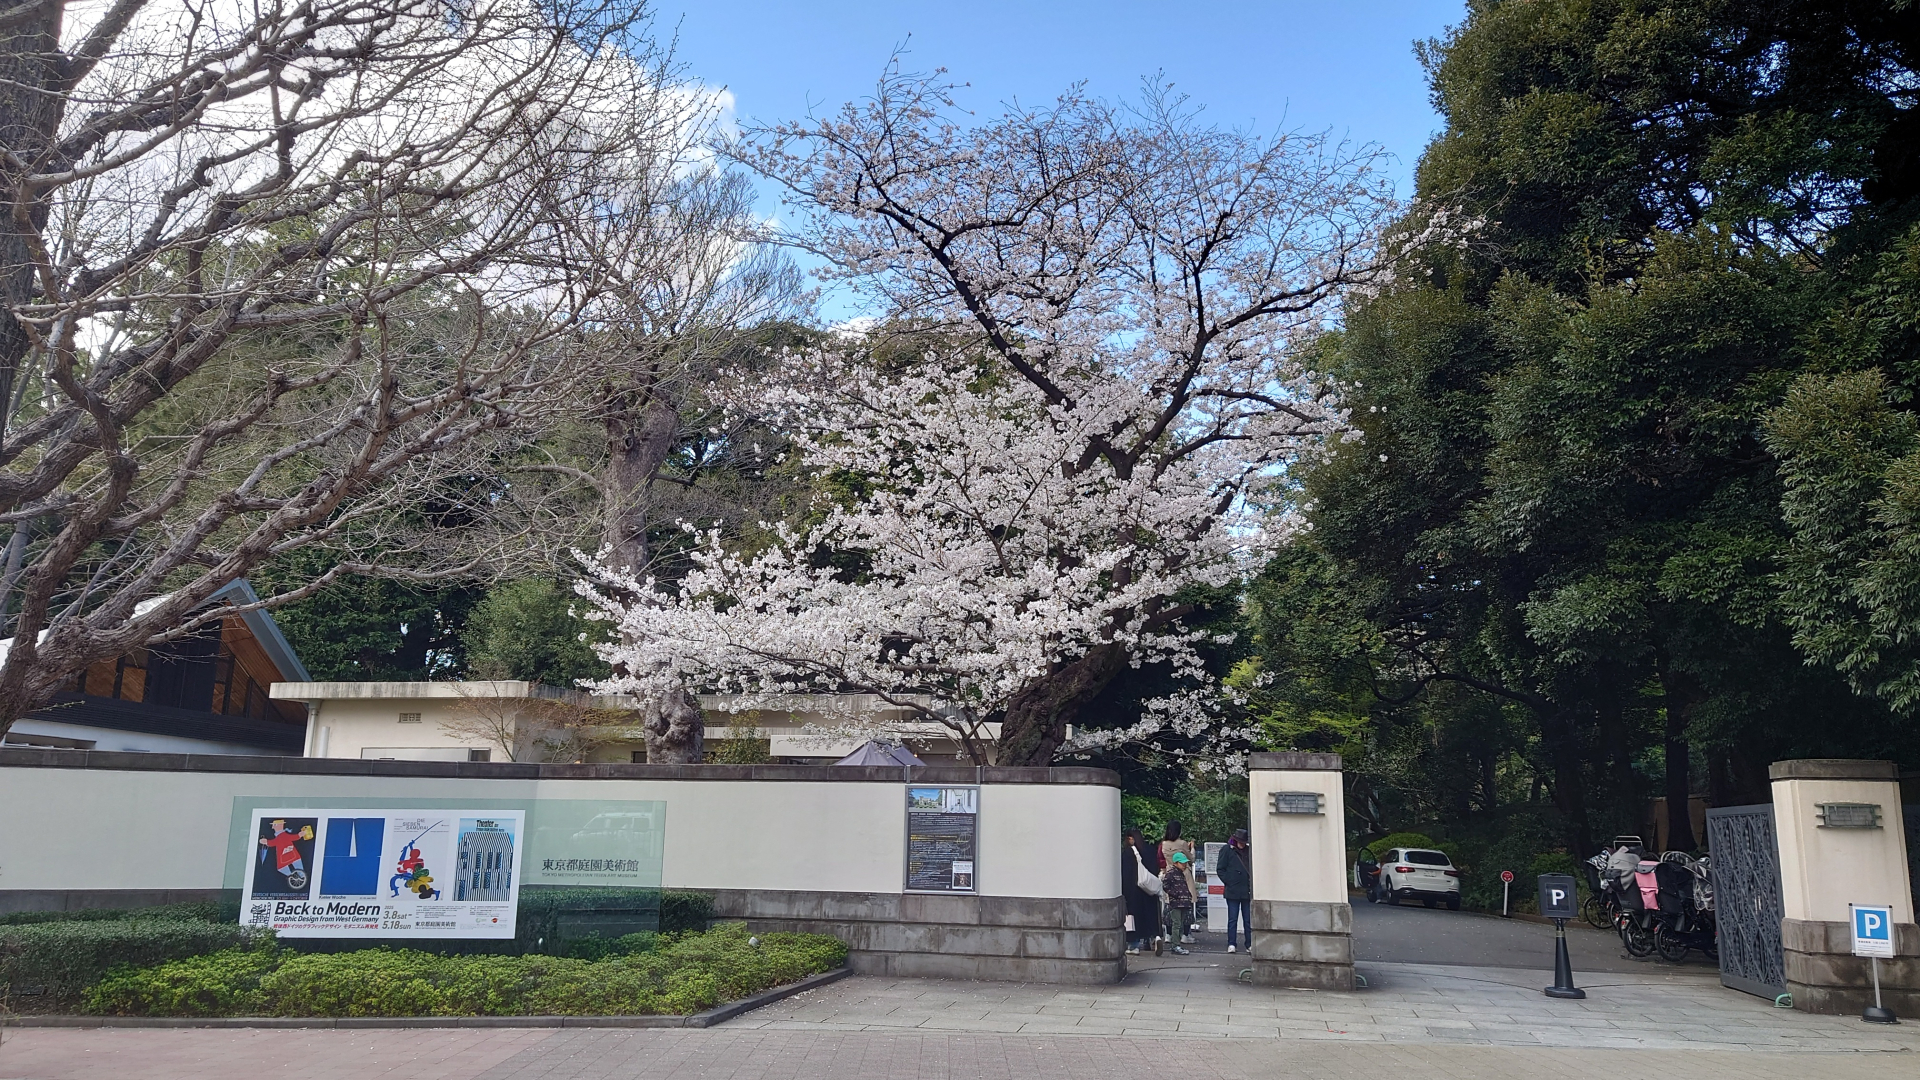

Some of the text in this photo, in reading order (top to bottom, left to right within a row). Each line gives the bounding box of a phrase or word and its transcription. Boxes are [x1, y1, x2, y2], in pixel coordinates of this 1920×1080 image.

[541, 858, 640, 872] 東京都庭園美術館
[1551, 889, 1565, 906] P
[274, 901, 381, 916] Back to Modern
[273, 915, 298, 923] Graphic
[297, 915, 319, 923] Design
[382, 920, 412, 930] 5.18sun
[1864, 913, 1881, 937] P
